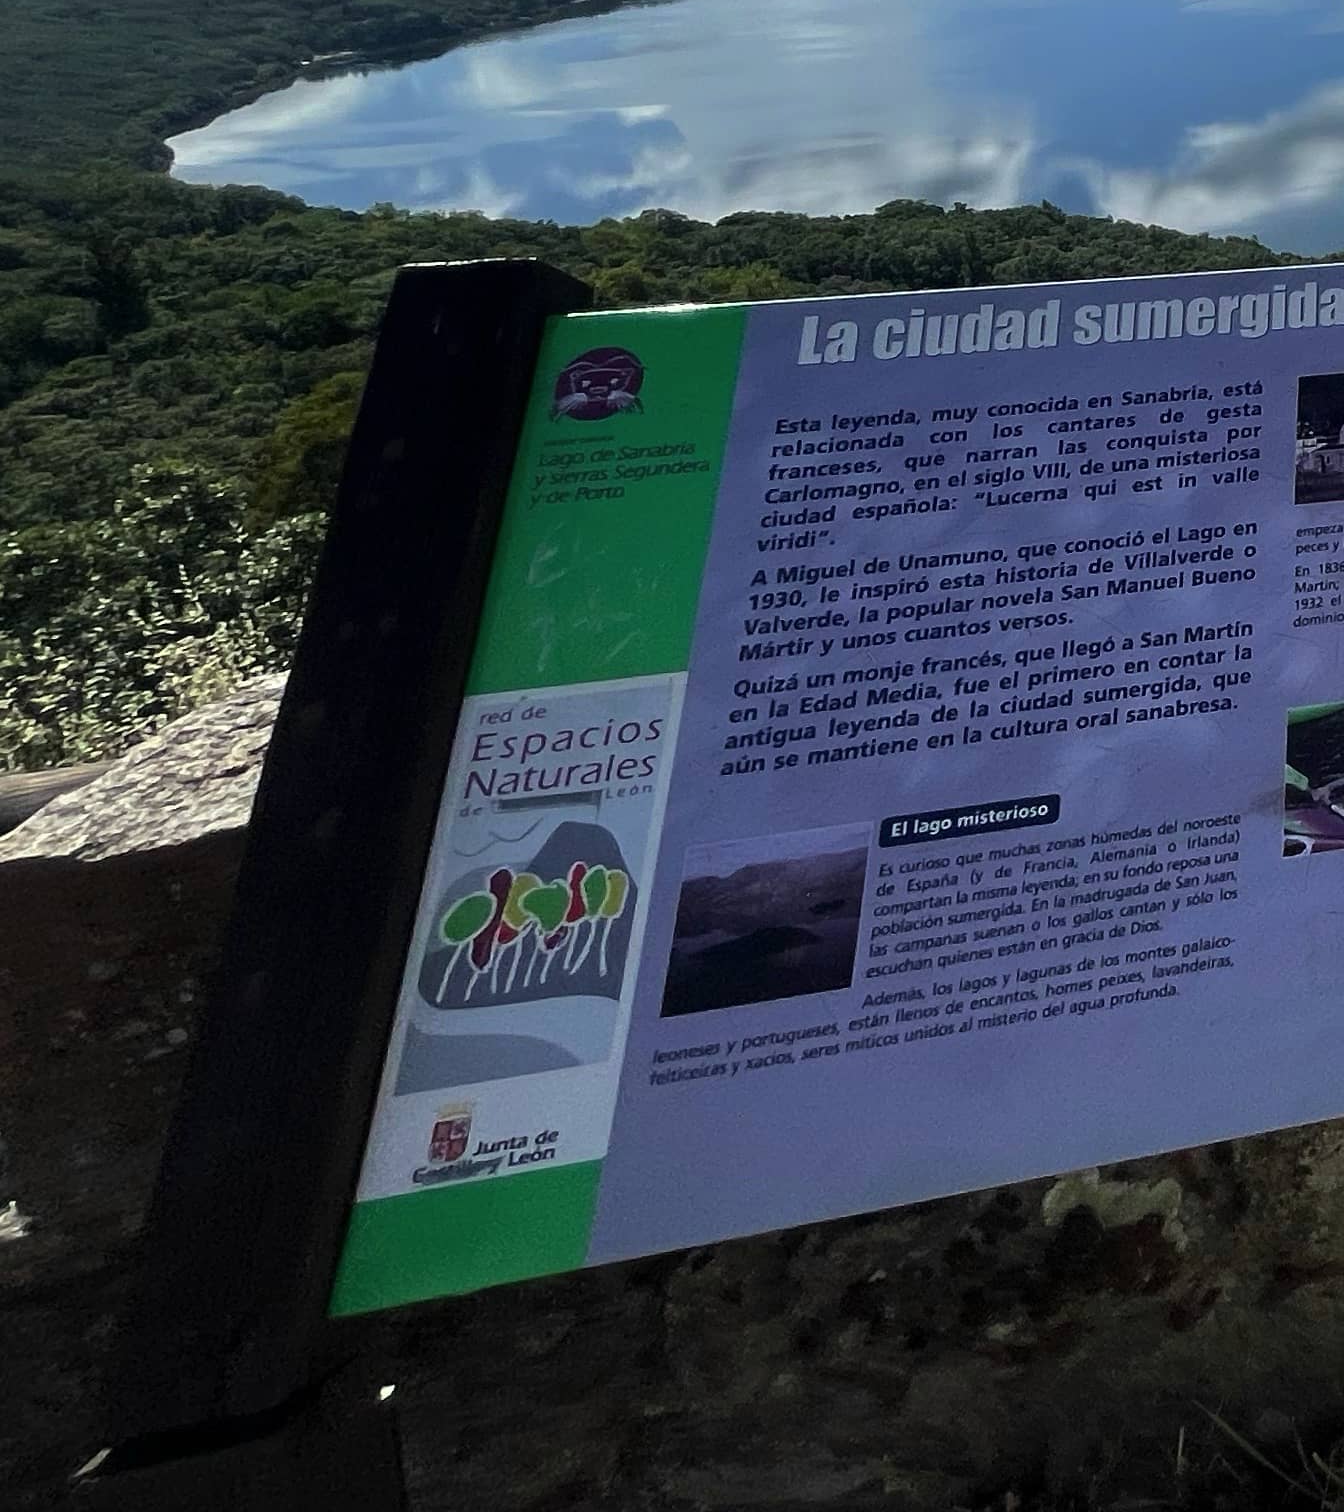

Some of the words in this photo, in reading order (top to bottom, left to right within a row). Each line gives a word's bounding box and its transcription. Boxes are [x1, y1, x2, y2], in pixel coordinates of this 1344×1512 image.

[796, 314, 858, 365] La
[871, 298, 1061, 360] ciudad
[769, 430, 905, 458] relacionada
[928, 429, 968, 445] con
[991, 421, 1024, 440] los
[1046, 414, 1136, 434] cantares
[1158, 406, 1185, 425] de
[1205, 401, 1262, 425] gesta
[773, 416, 821, 435] Esta
[830, 407, 921, 434] leyenda,
[930, 405, 979, 424] muy
[986, 394, 1079, 417] conocida
[1086, 394, 1113, 409] en
[1120, 383, 1214, 407] Sanabria,
[1222, 378, 1263, 398] está
[763, 479, 905, 505] Carlomagno,
[912, 476, 940, 491] en
[946, 468, 967, 488] el
[971, 464, 1025, 488] siglo
[1031, 461, 1071, 480] VIII,
[1078, 457, 1105, 476] de
[1110, 457, 1149, 473] una
[1155, 445, 1261, 469] misteriosa
[767, 459, 882, 481] franceses,
[902, 448, 946, 473] que
[965, 445, 1038, 464] narran
[1056, 438, 1088, 456] las
[1105, 427, 1208, 451] conquista
[1226, 424, 1262, 445] por
[759, 503, 837, 529] ciudad
[851, 494, 958, 522] española:
[1083, 477, 1117, 502] qui
[1130, 474, 1164, 493] est
[1177, 471, 1197, 489] in
[1210, 465, 1260, 485] valle
[470, 718, 664, 765] Espacios
[479, 707, 514, 726] red
[520, 705, 548, 721] de
[458, 804, 484, 818] de
[605, 783, 653, 800] León
[463, 753, 657, 800] Naturales
[877, 861, 894, 878] Es
[897, 856, 951, 874] curioso
[954, 851, 983, 868] que
[987, 841, 1042, 861] muchas
[1045, 835, 1086, 853] zonas
[1090, 823, 1153, 846] húmedas
[1156, 818, 1178, 836] del
[1182, 813, 1241, 832] noroeste
[890, 819, 908, 838] El
[912, 817, 952, 836] lago
[956, 803, 1049, 828] misterioso
[472, 1135, 529, 1156] Junta
[534, 1129, 561, 1145] de
[507, 1144, 556, 1167] León
